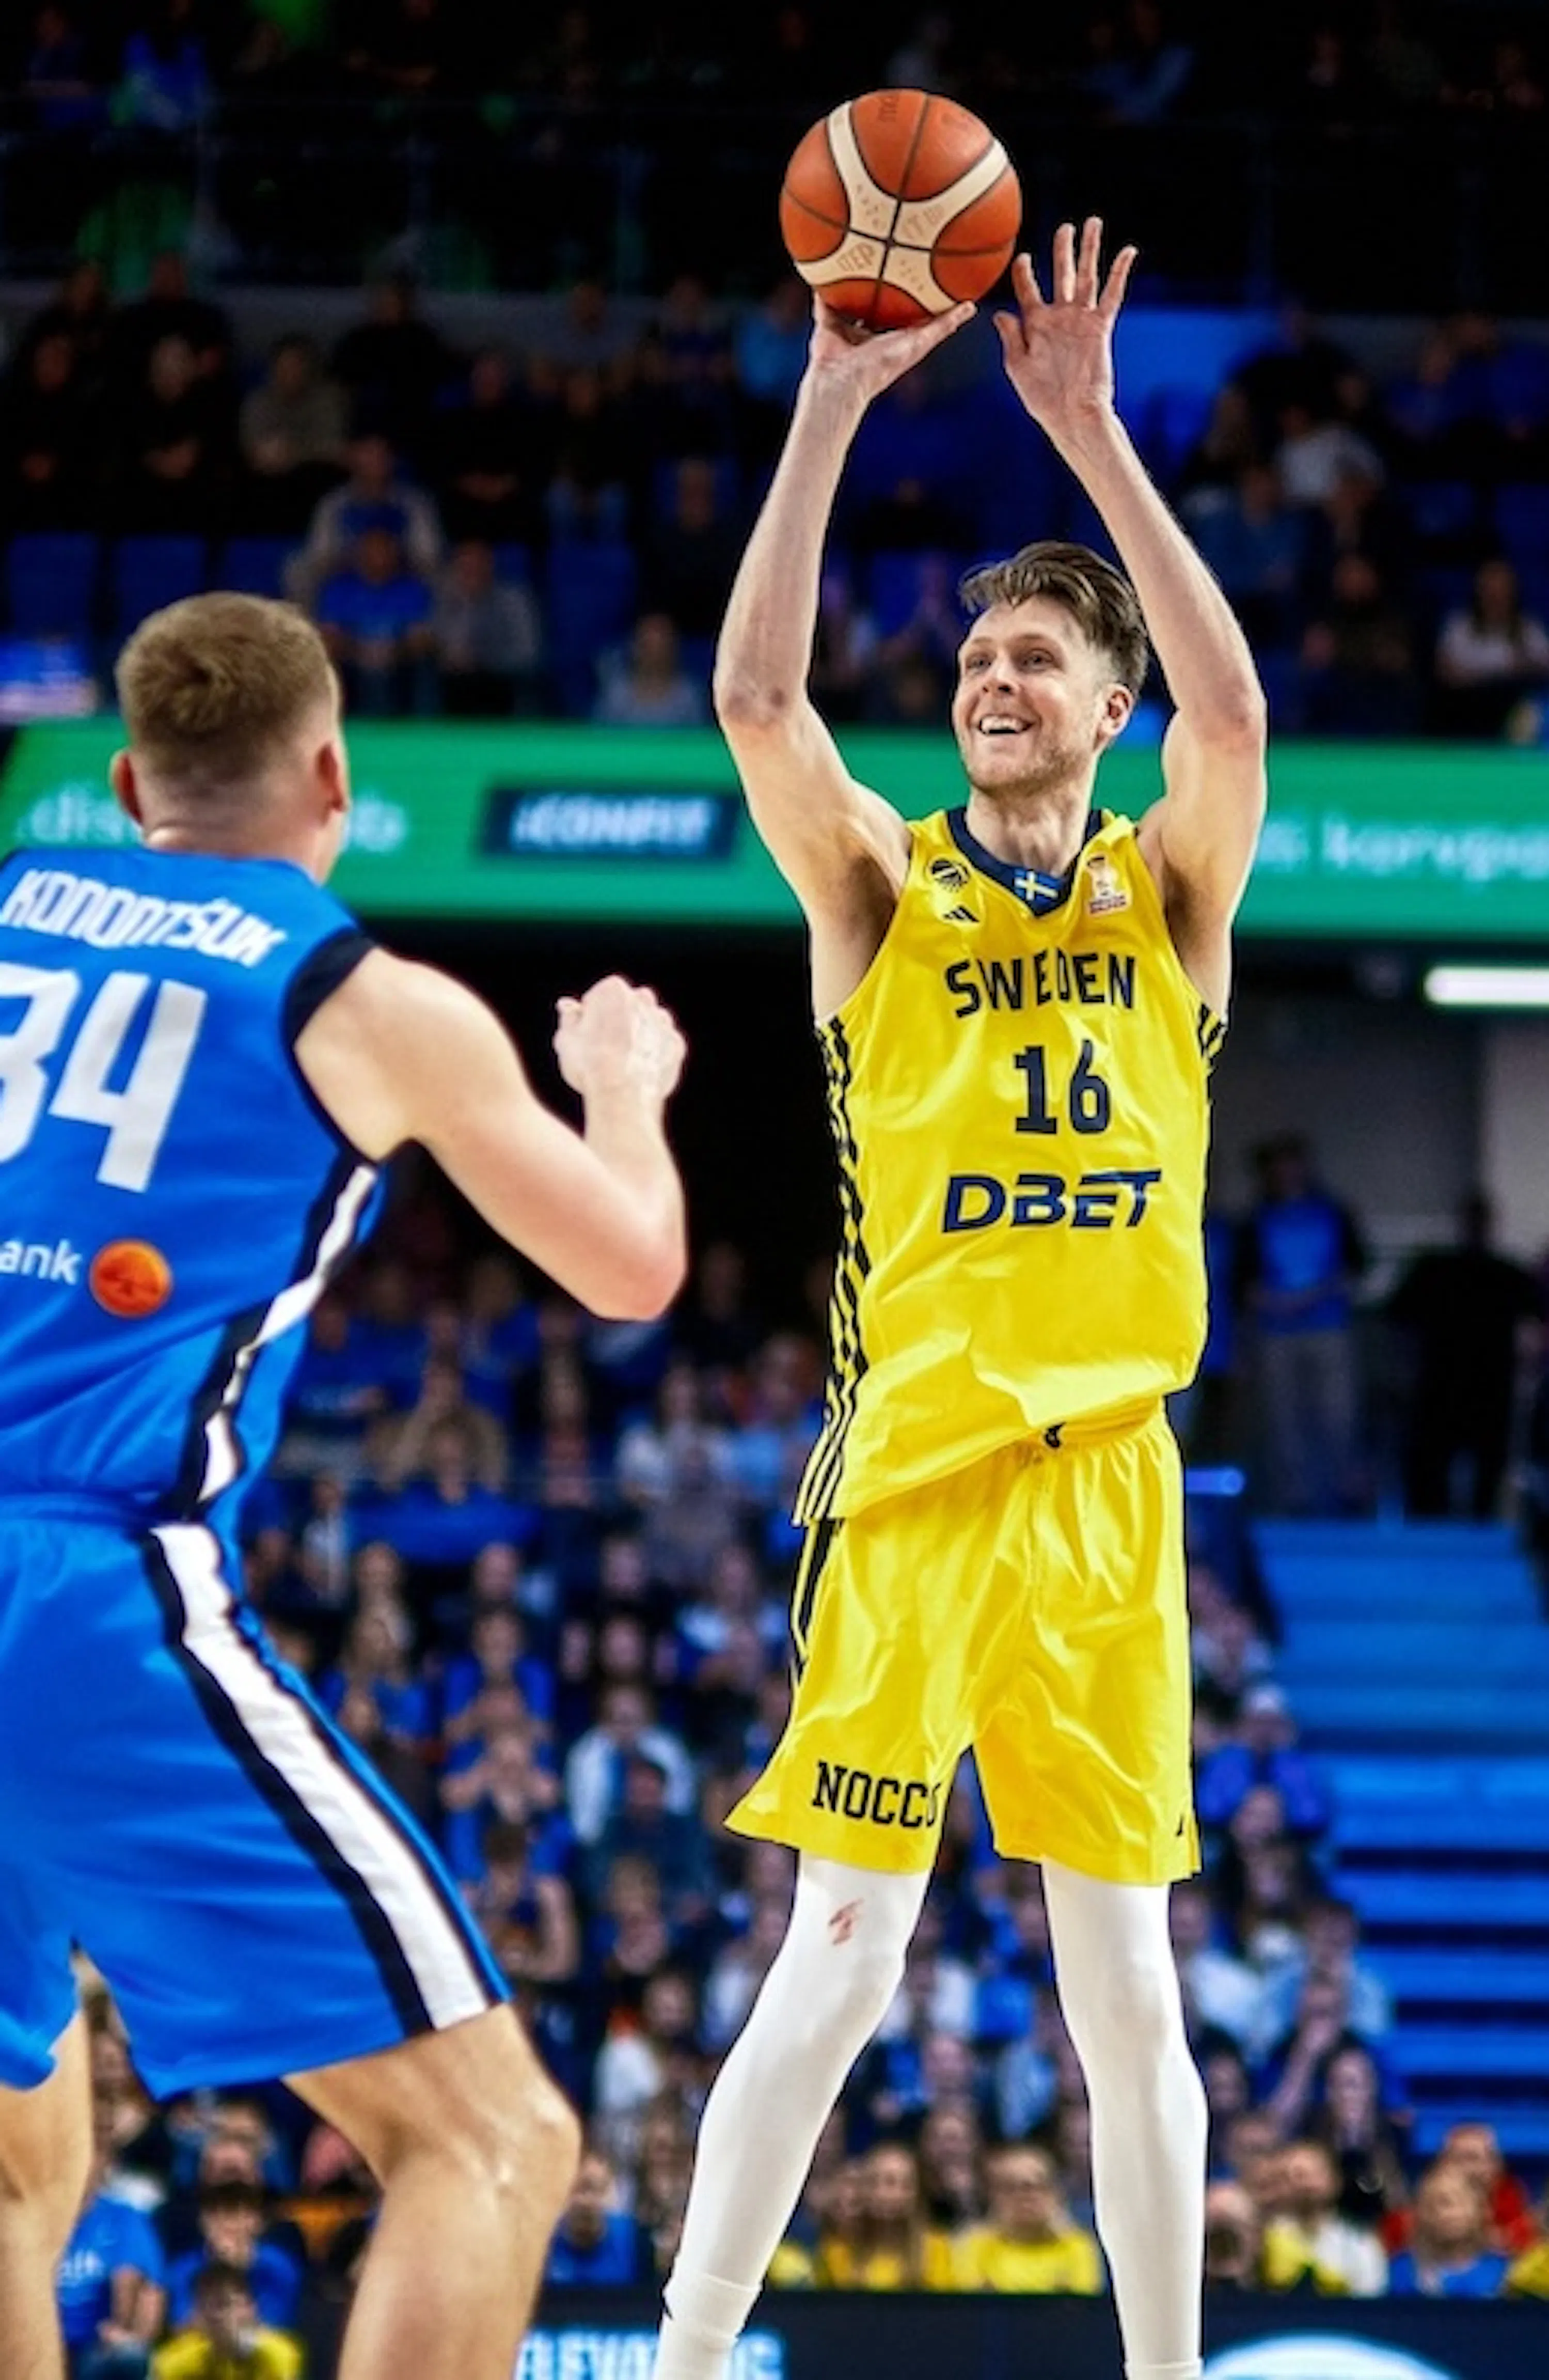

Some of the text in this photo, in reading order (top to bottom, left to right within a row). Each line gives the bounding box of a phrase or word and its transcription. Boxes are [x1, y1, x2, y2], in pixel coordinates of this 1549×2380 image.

[944, 947, 1135, 1018] SWEDEN
[0, 961, 208, 1194] 34
[1013, 1040, 1111, 1135] 16
[942, 1169, 1162, 1233] DBET
[0, 1238, 83, 1286] ank
